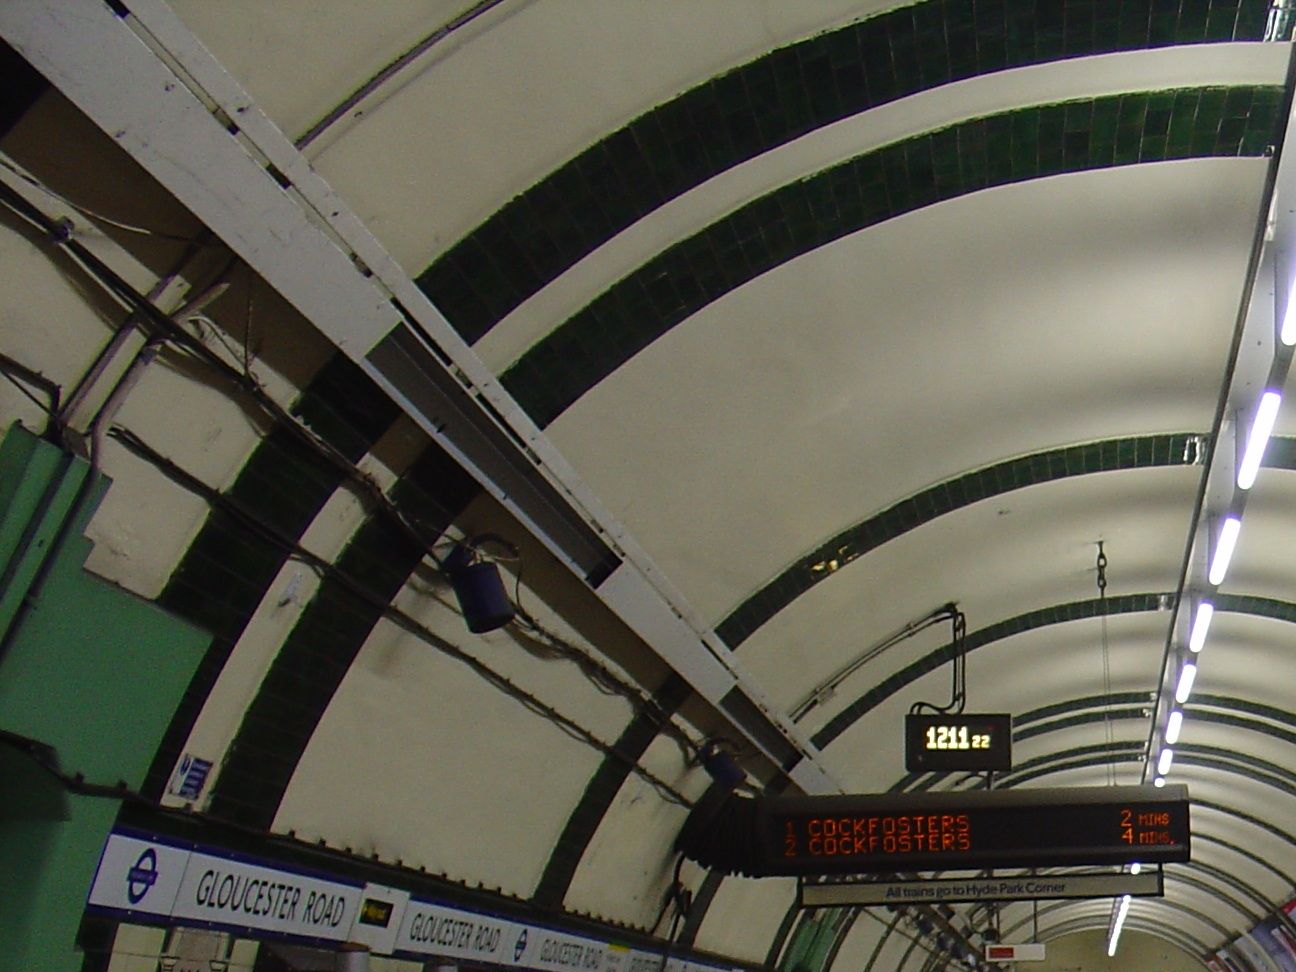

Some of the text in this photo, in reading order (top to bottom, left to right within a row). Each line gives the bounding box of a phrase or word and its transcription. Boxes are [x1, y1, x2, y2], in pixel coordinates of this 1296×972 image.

[972, 735, 990, 749] 22
[808, 815, 971, 837] COCKFOSTERS
[1120, 810, 1132, 827] 2
[1139, 813, 1169, 827] MINS
[785, 839, 797, 857] 2
[808, 833, 971, 856] COCKFOSTERS
[1120, 827, 1133, 844] 4
[196, 869, 301, 920] GLOUCESTER
[302, 890, 345, 928] ROAD
[886, 882, 1066, 898] All trains go to Hyde Park Corner
[410, 912, 474, 948] GLOUCESTER
[474, 925, 501, 953] ROAD
